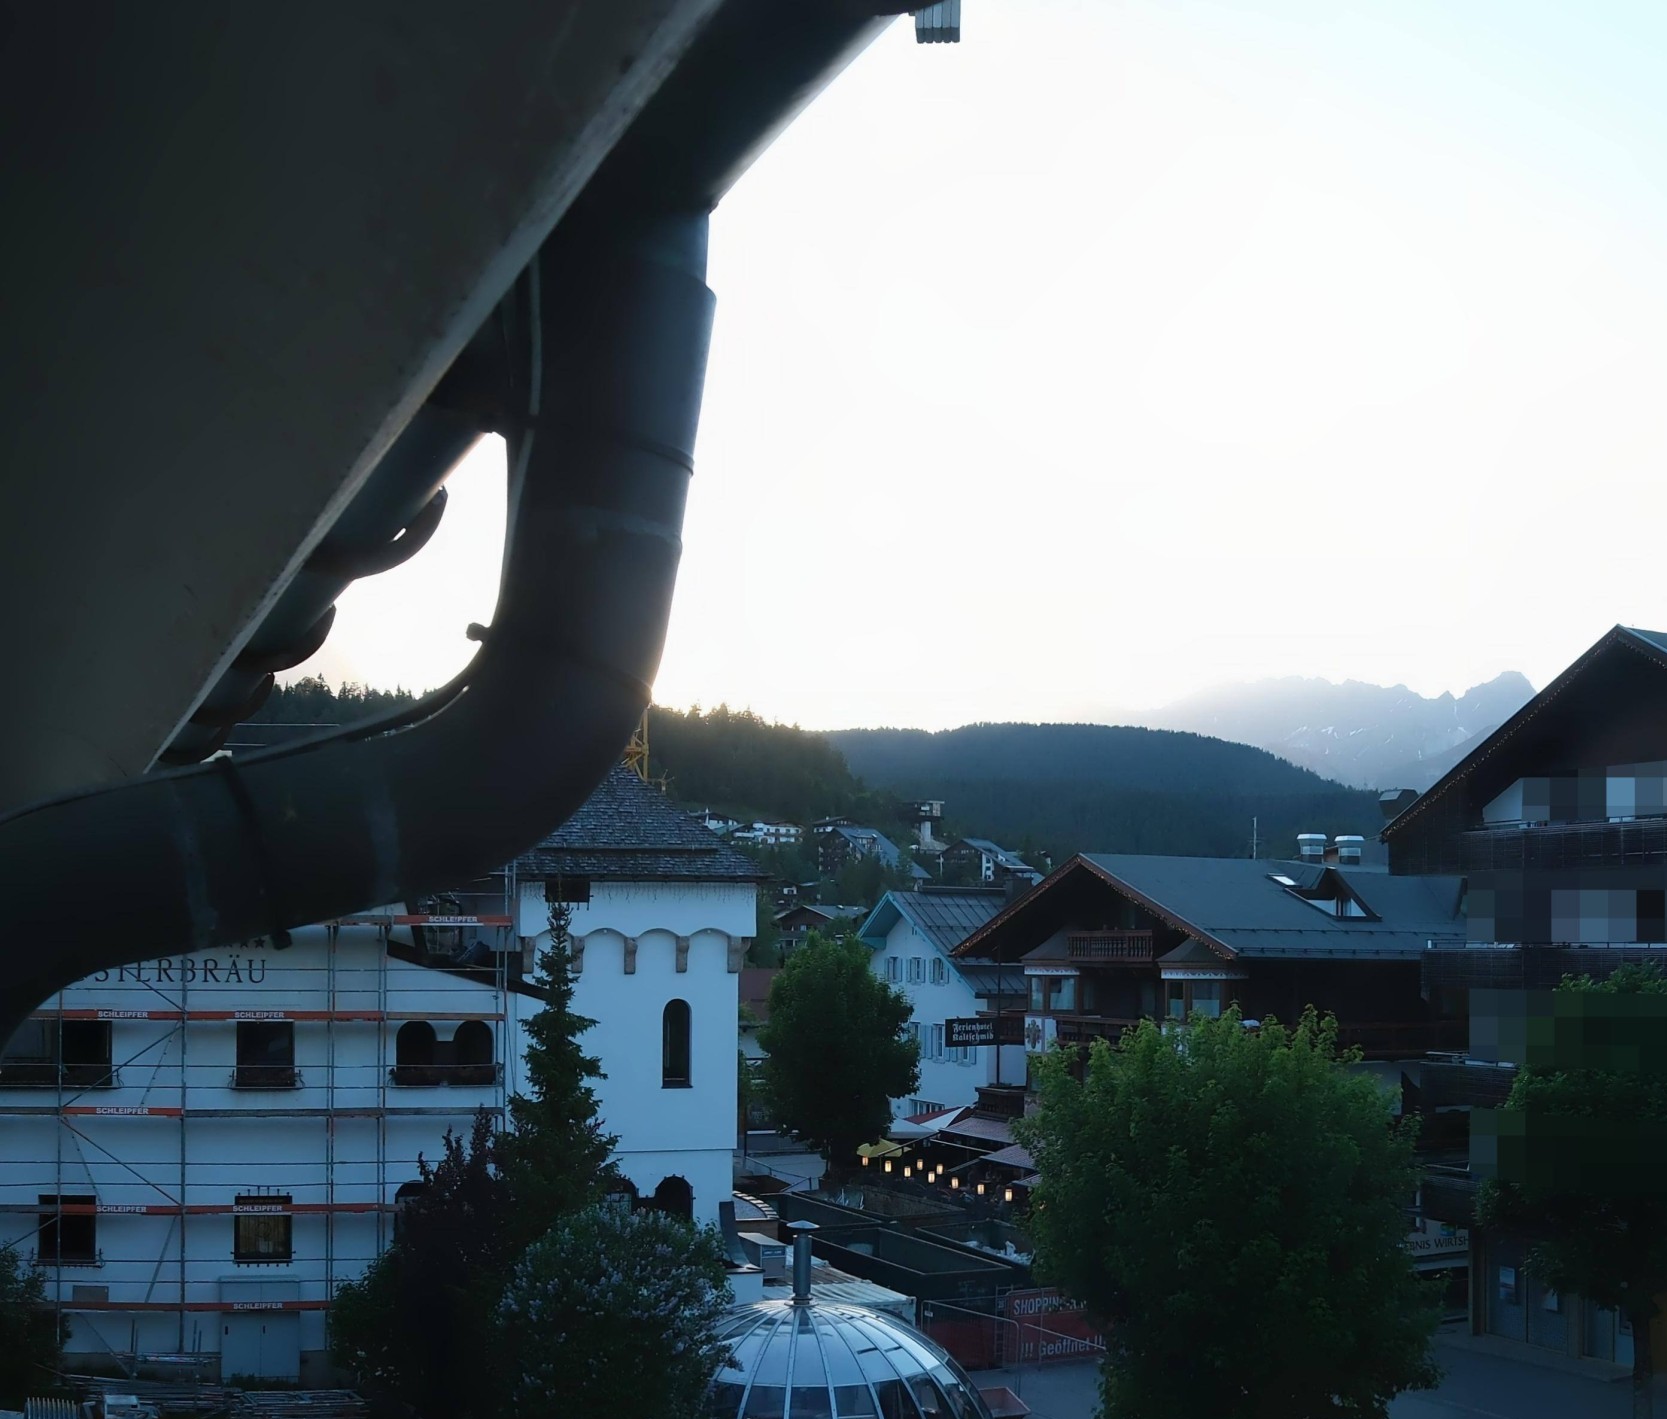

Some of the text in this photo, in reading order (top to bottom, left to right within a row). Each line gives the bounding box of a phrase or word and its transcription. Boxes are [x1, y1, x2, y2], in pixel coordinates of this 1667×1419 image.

[428, 915, 478, 923] SCHLEIPFER
[80, 954, 266, 984] STERBRÄU
[97, 1010, 149, 1019] SCHLEIPFER
[234, 1010, 285, 1019] SCHLEIPFER
[95, 1106, 149, 1115] SCHLEIPFER
[96, 1205, 147, 1213] SCHLEIPFER
[232, 1204, 283, 1212] SCHLEIPFER
[233, 1302, 283, 1310] SCHLEIPFER
[1014, 1296, 1062, 1316] SHOPPIN
